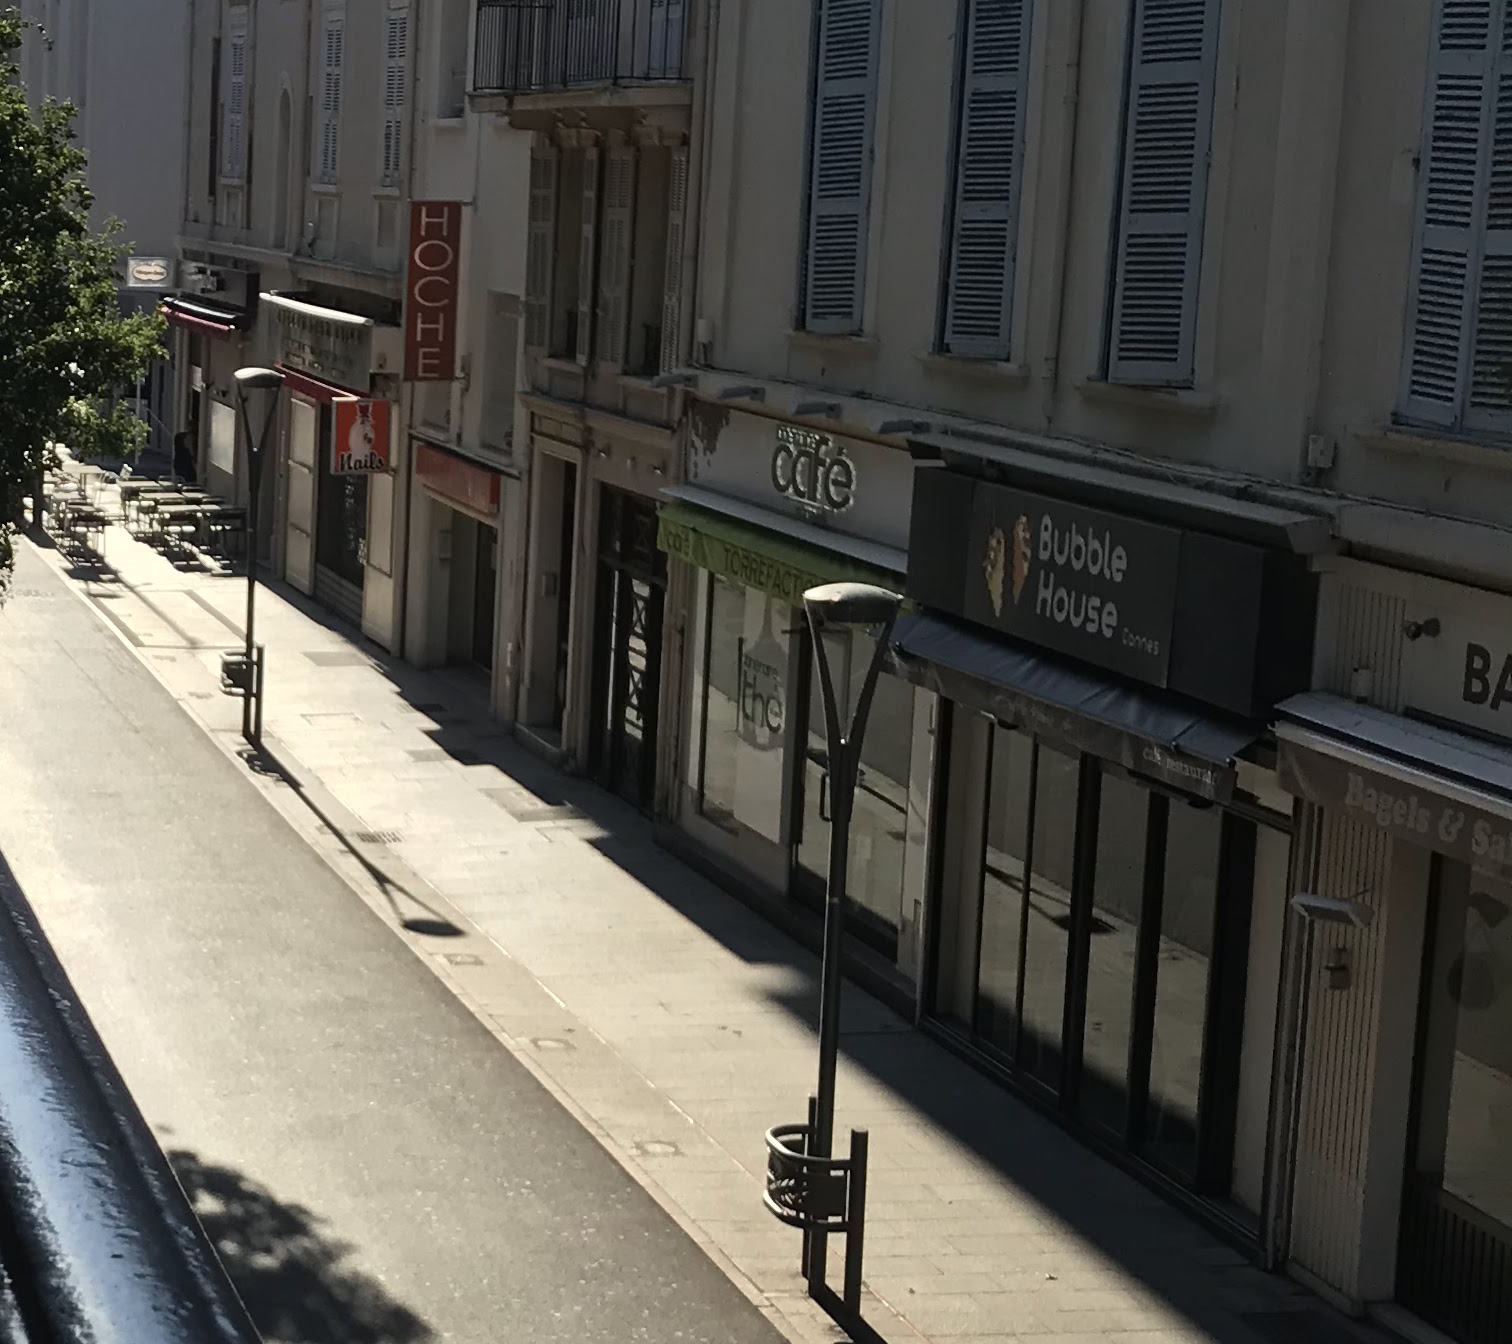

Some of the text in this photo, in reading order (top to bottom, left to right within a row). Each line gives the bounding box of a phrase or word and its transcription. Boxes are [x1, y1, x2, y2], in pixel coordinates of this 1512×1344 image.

[413, 206, 453, 379] HOCHE
[340, 451, 384, 471] Nails
[1038, 513, 1128, 583] Bubble
[1036, 568, 1118, 639] House
[1344, 771, 1431, 834] Bagels
